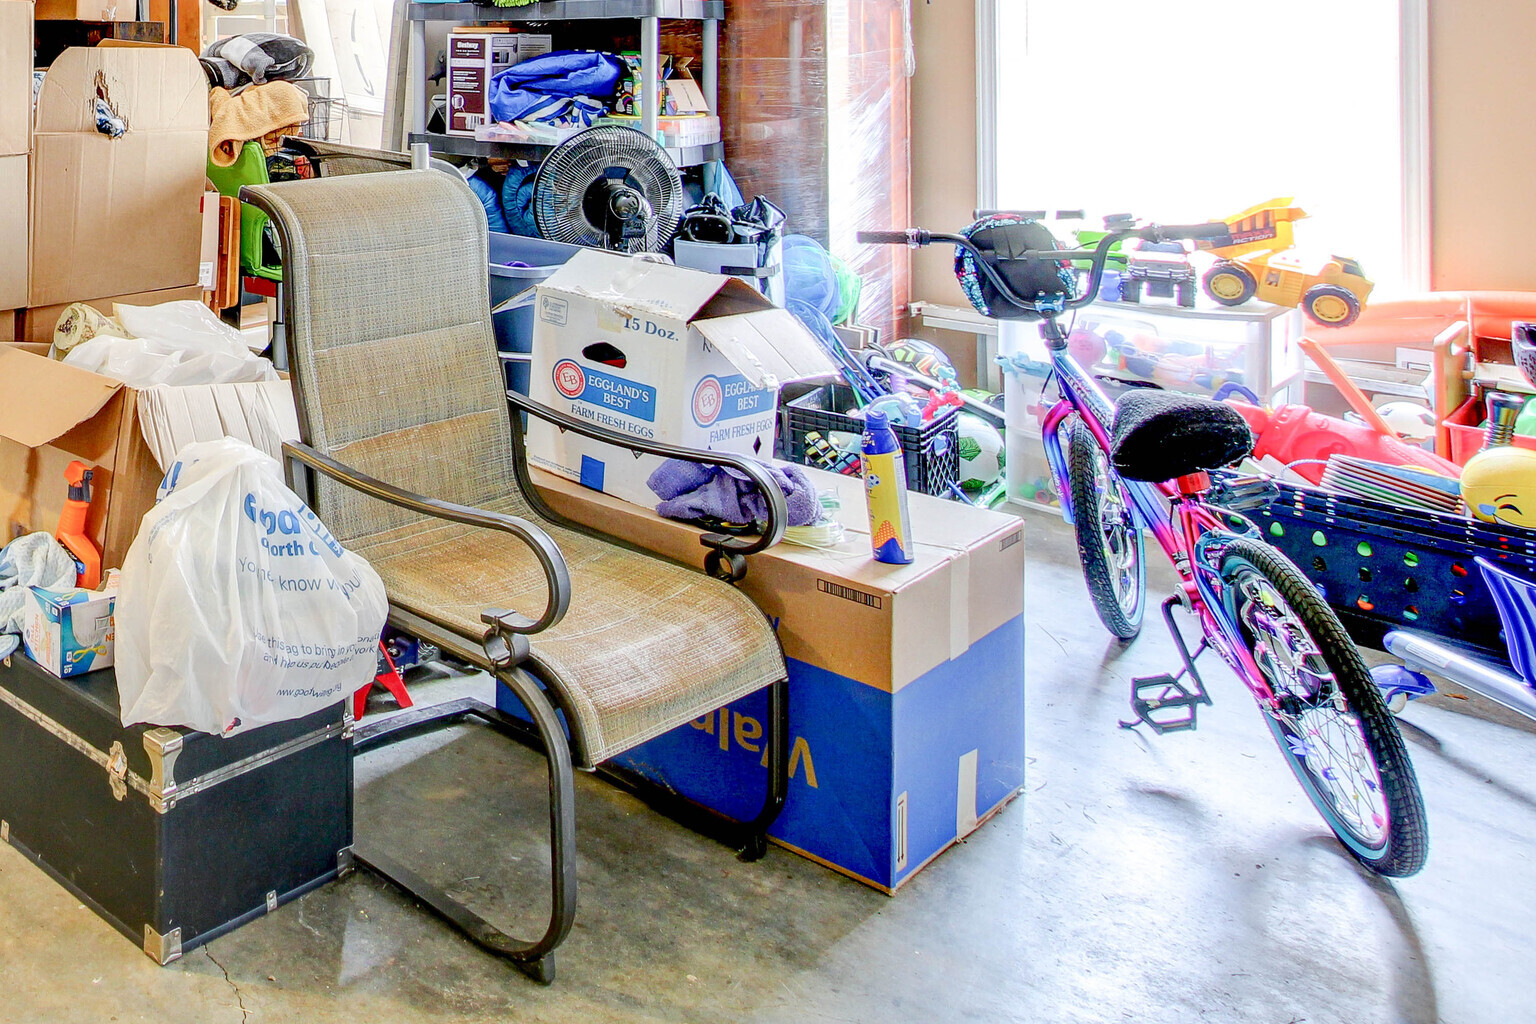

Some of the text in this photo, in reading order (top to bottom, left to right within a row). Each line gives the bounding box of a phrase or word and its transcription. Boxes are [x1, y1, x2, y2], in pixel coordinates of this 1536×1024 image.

[623, 316, 680, 342] 15 Doz.
[603, 392, 632, 410] BEST
[737, 394, 760, 411] BEST
[570, 403, 654, 439] FARM FRESH EGGS
[709, 417, 773, 443] FARM FRESH EGGS
[278, 575, 322, 592] know
[300, 644, 313, 655] to
